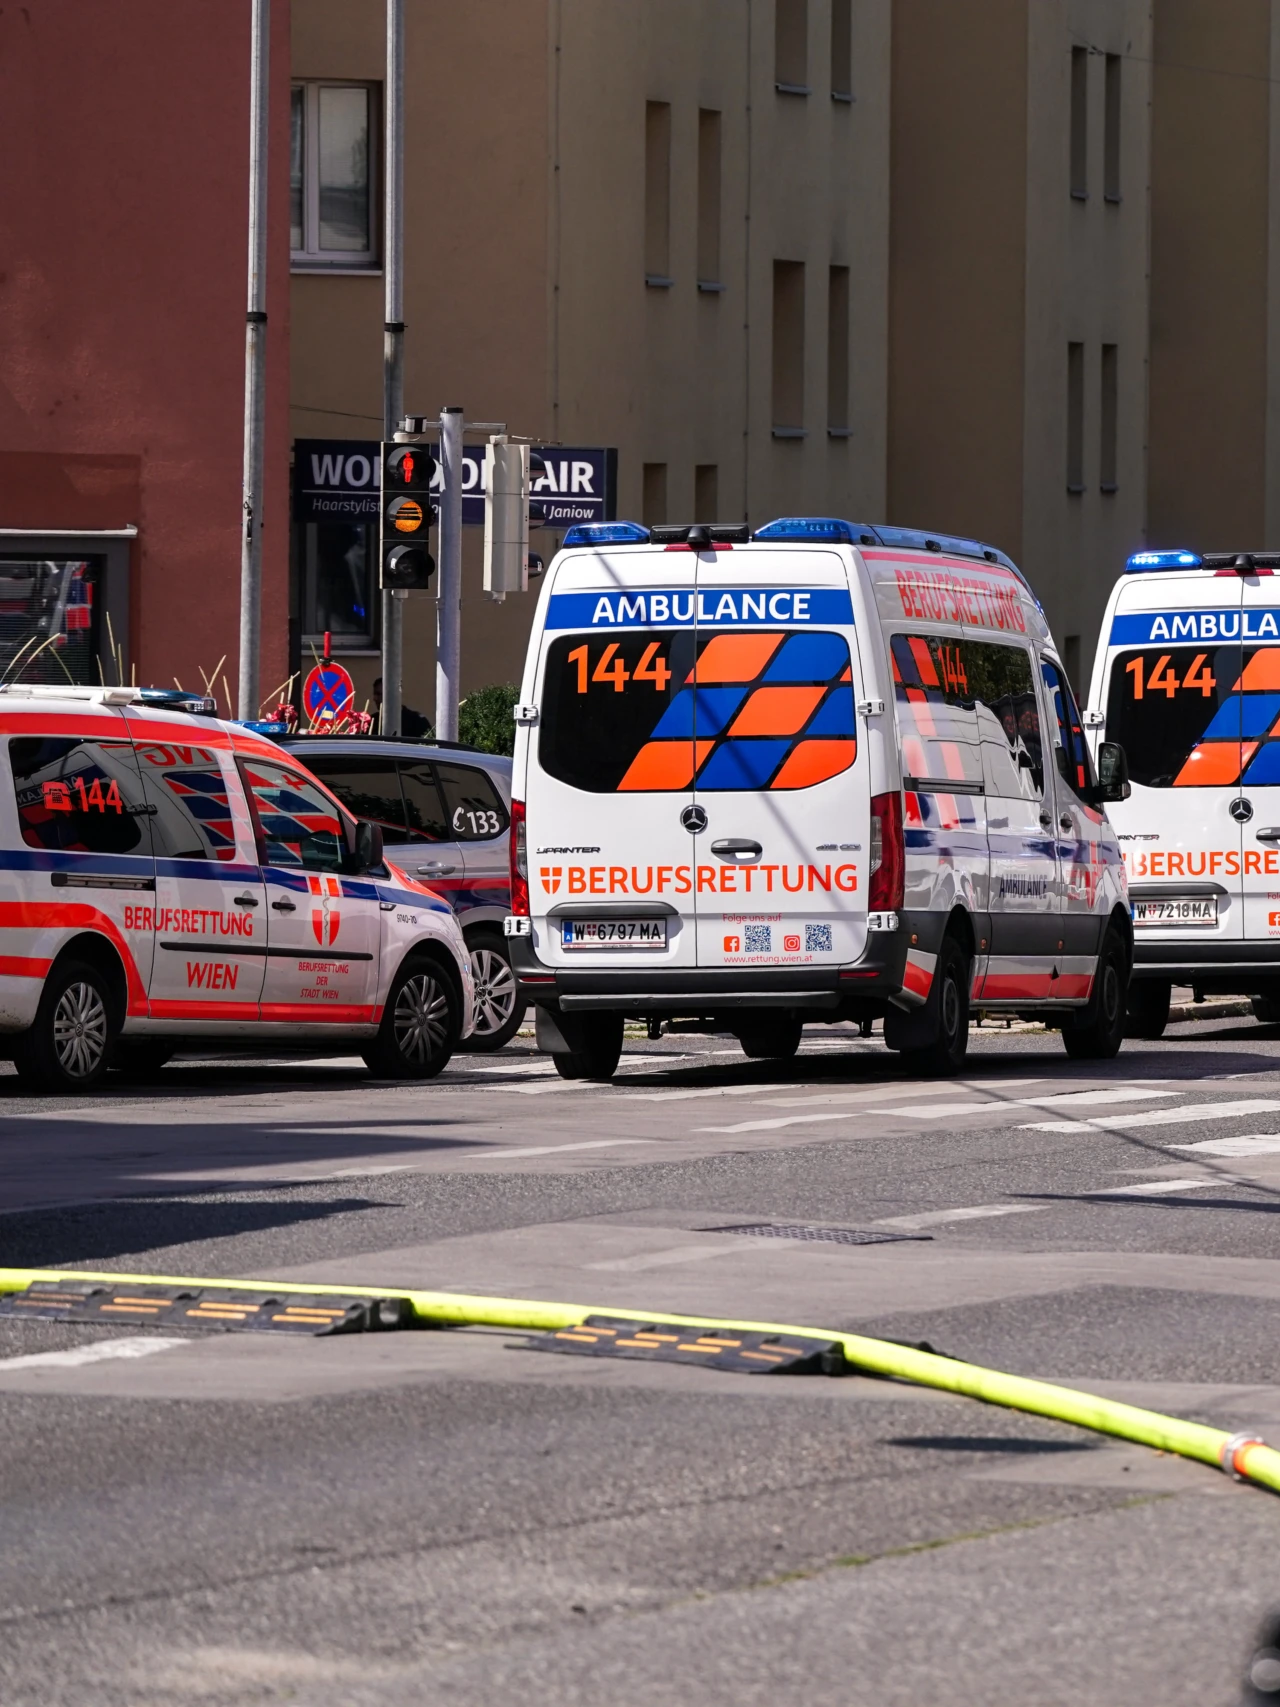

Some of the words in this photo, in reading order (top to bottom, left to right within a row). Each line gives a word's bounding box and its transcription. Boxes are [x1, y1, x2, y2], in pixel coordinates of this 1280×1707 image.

[530, 461, 594, 493] AIR
[548, 505, 594, 520] Janiow
[591, 593, 811, 623] AMBULANCE
[894, 569, 1026, 632] BERUFSRETTUNG
[568, 641, 672, 694] 144
[938, 646, 968, 694] 144
[1125, 654, 1216, 700] 144
[74, 776, 123, 814] 144
[466, 810, 500, 834] 133
[568, 864, 858, 893] BERUFSRETTUNG
[999, 873, 1048, 900] AMBULANCE
[124, 906, 254, 937] BERUFSRETTUNG
[722, 913, 747, 924] Folge
[749, 914, 765, 922] uns
[767, 913, 782, 922] auf
[1137, 904, 1147, 918] W
[1158, 903, 1190, 918] 7218
[1193, 902, 1211, 918] MA
[574, 923, 585, 940] W
[597, 923, 636, 940] 6797
[640, 923, 661, 940] MA
[298, 961, 349, 974] BERUFSRETTUNG
[724, 954, 813, 964] www.rettung.wien.at
[187, 962, 239, 990] WIEN
[316, 975, 328, 986] DER
[300, 988, 321, 998] STADT
[322, 989, 339, 999] WIEN
